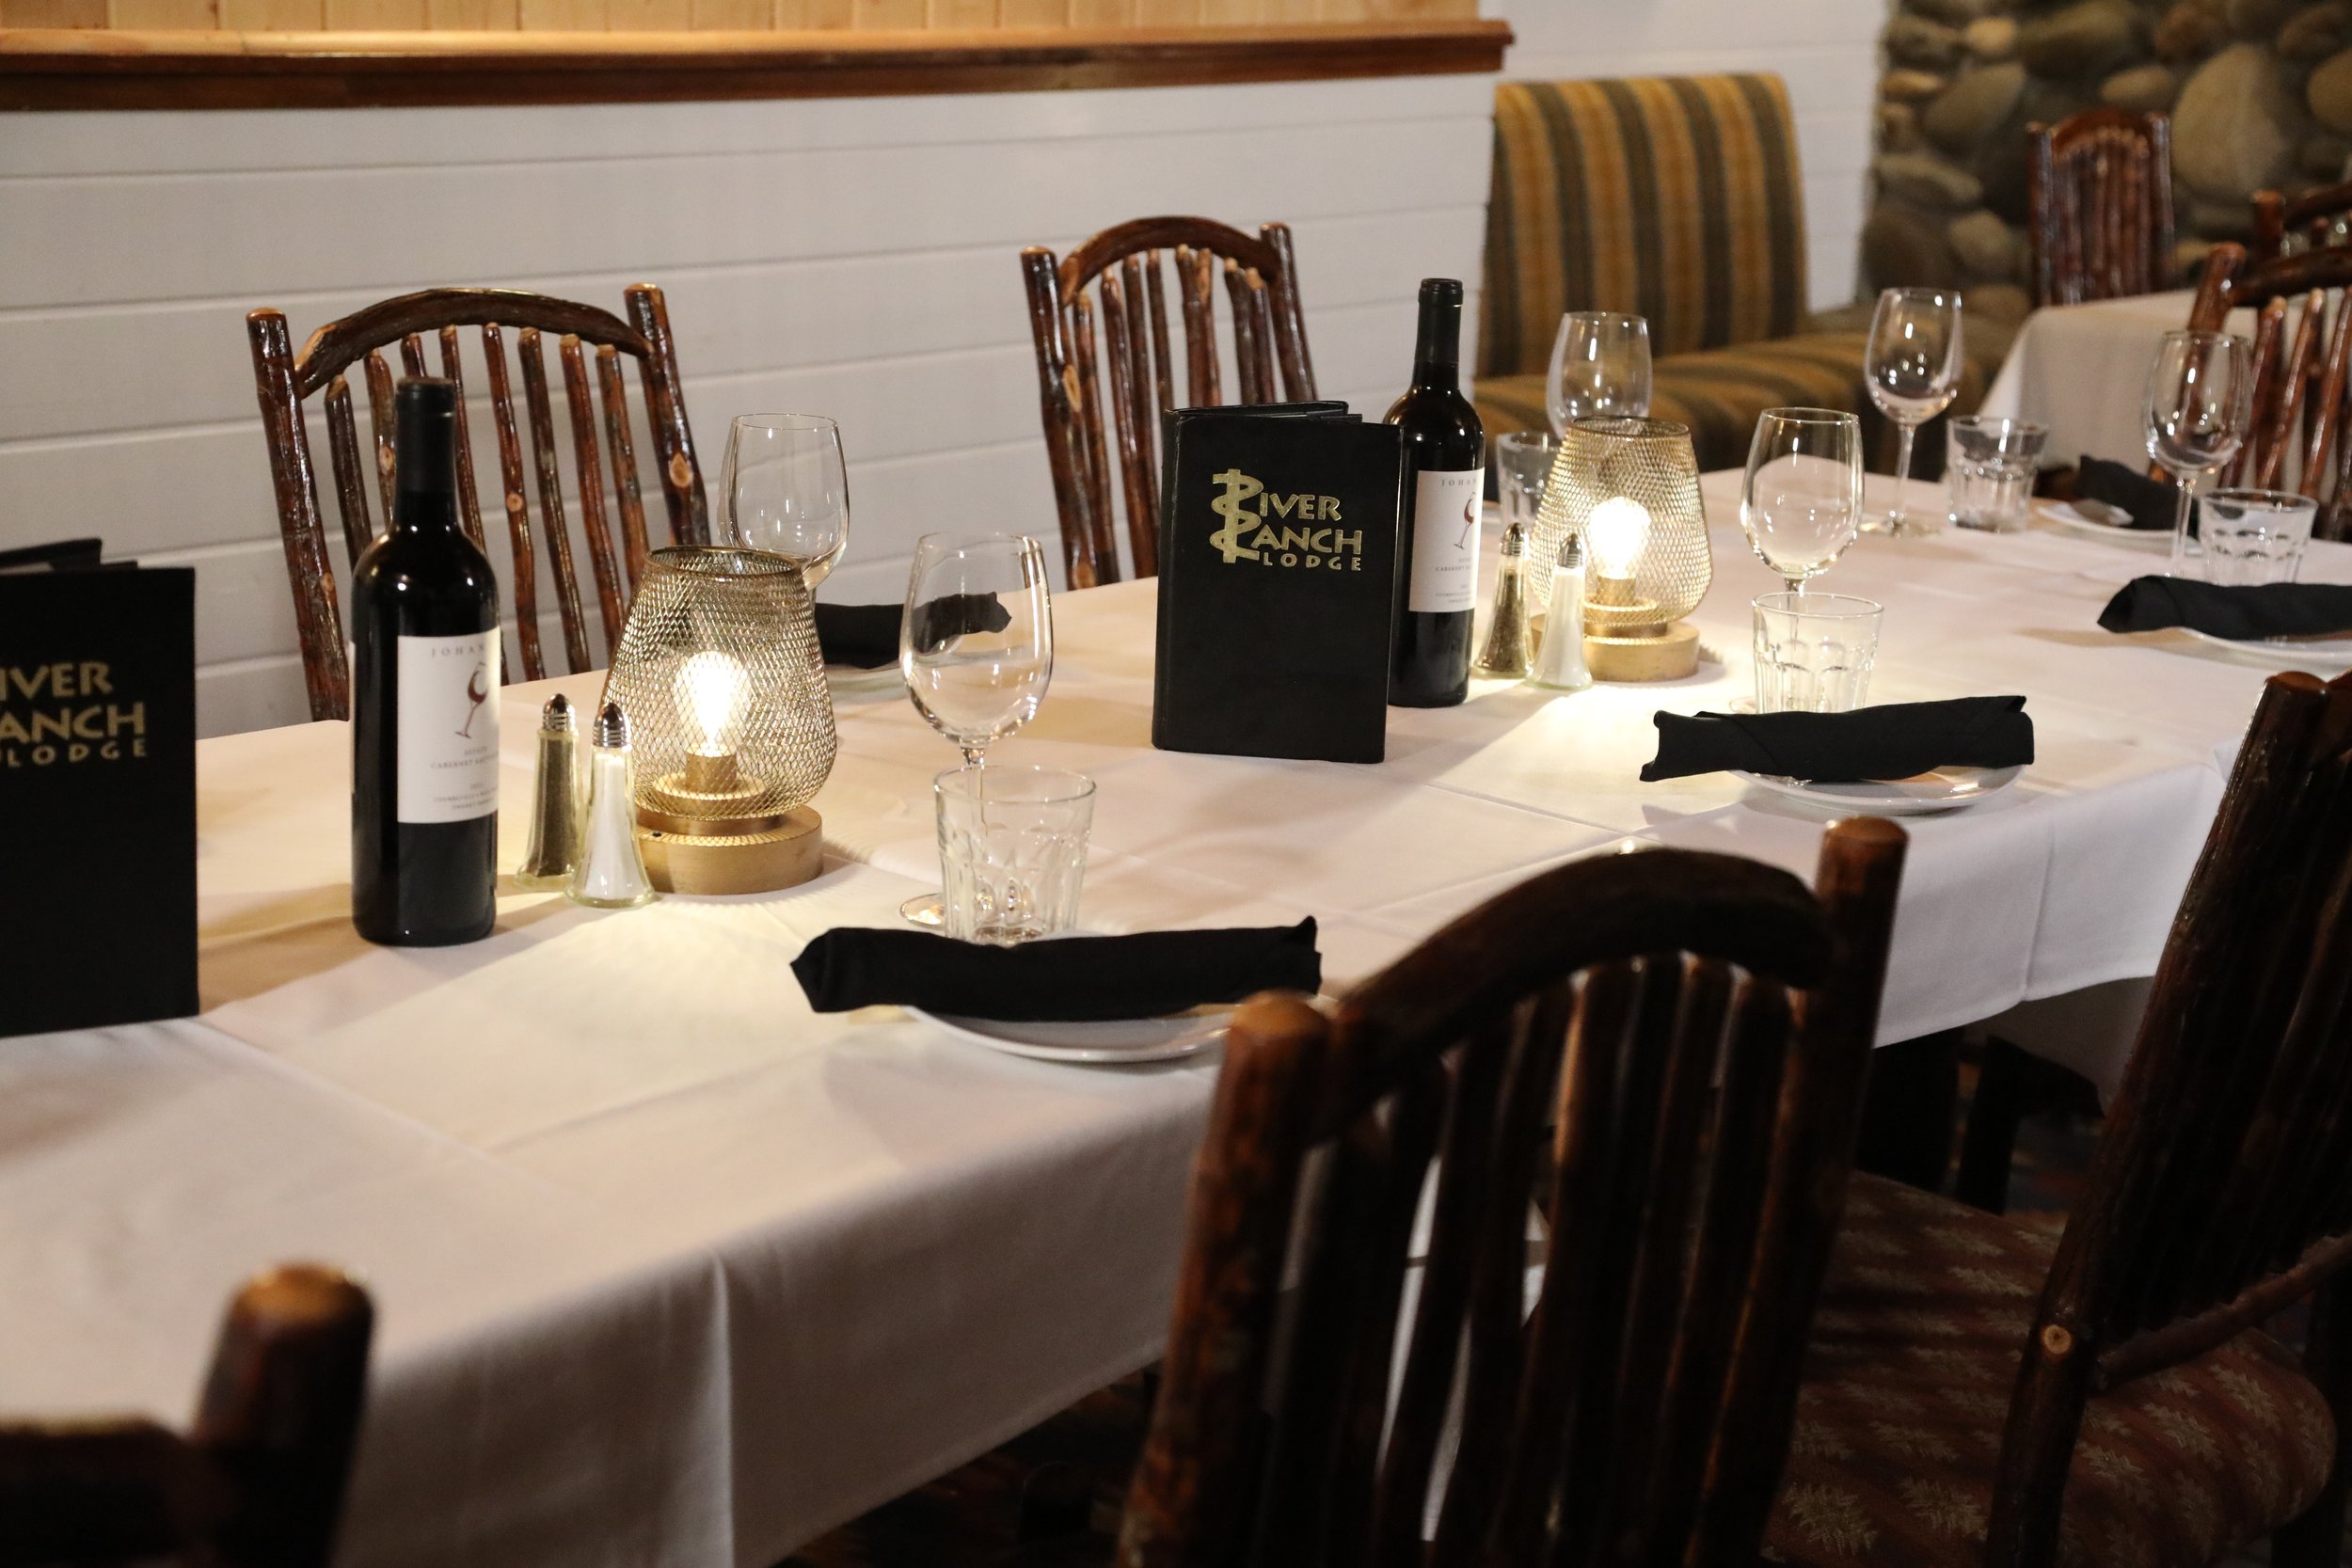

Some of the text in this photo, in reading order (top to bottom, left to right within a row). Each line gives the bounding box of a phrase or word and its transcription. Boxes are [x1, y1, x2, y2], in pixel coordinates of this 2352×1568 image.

[1211, 468, 1342, 521] RIVER
[1209, 509, 1362, 563] RANCH
[1263, 552, 1361, 572] LODGE
[0, 661, 114, 701] IVER
[0, 702, 145, 744] ANCH
[8, 737, 146, 768] LODGE
